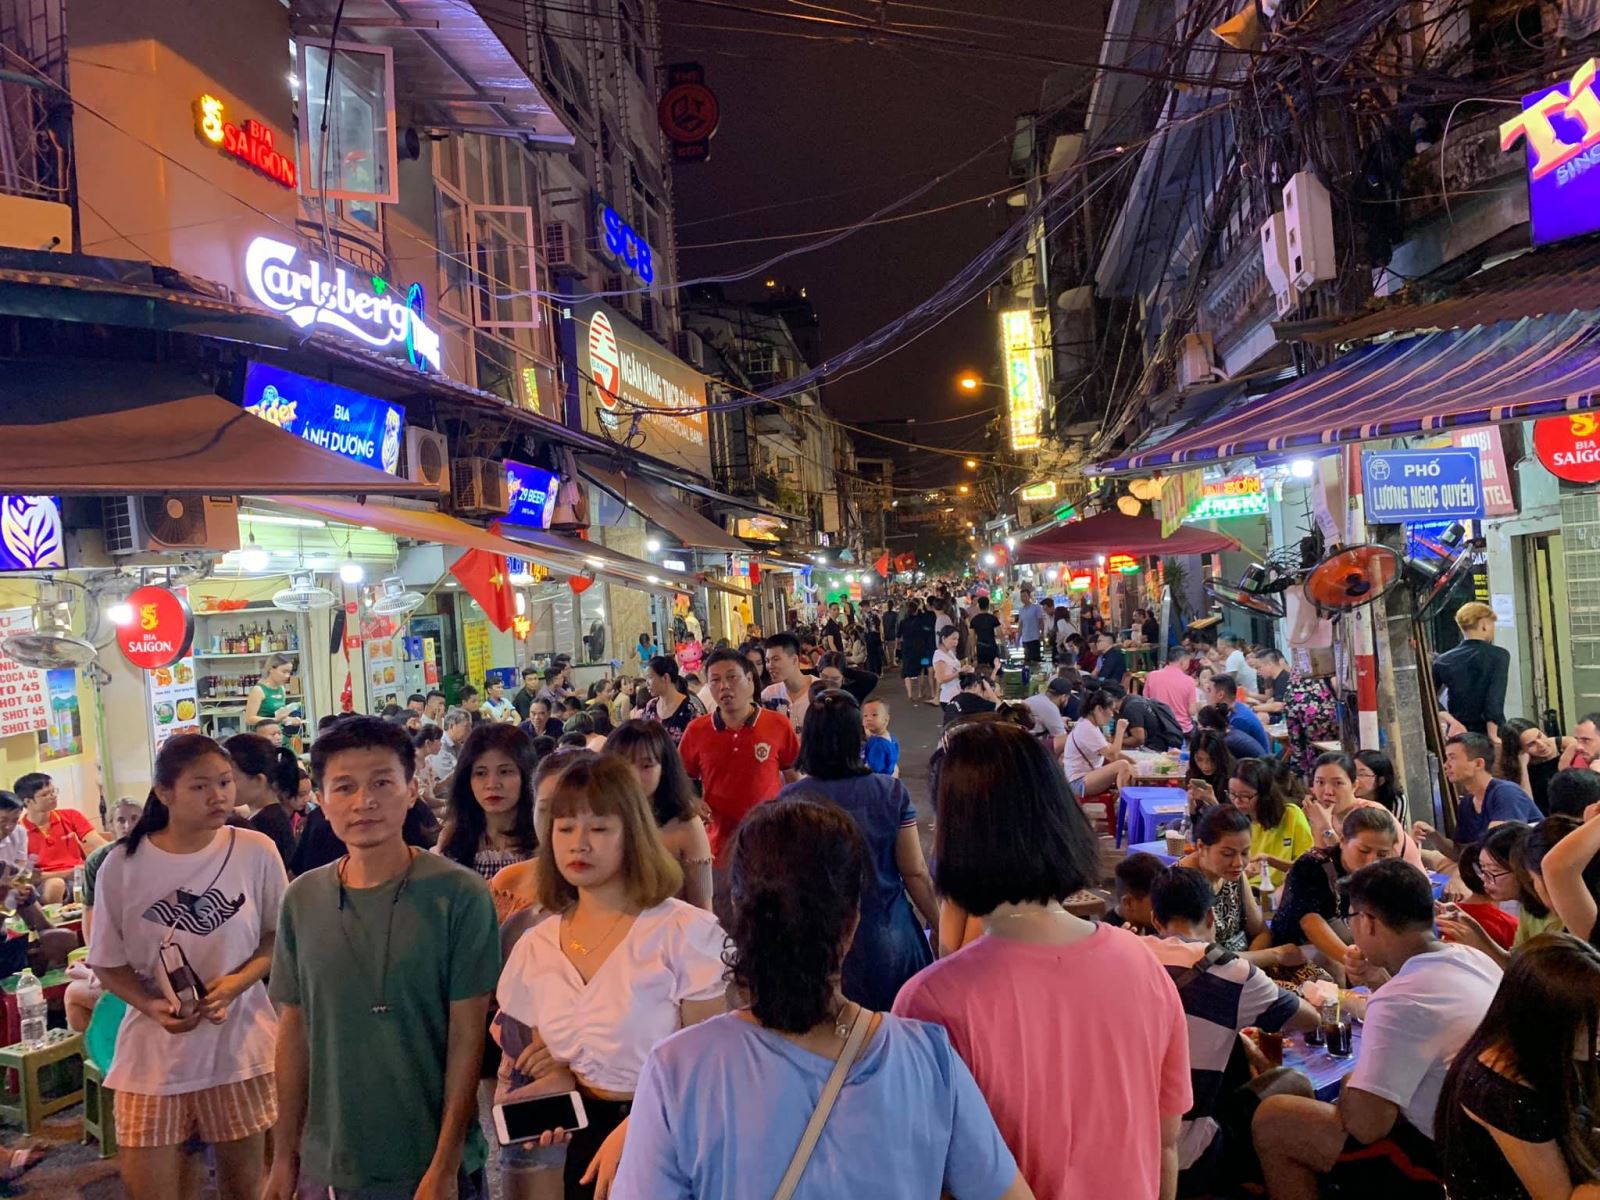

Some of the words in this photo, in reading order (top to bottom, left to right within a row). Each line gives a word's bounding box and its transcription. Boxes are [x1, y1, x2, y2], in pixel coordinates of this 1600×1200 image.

[250, 120, 273, 147] BIA
[224, 123, 296, 187] SAIGON
[604, 207, 653, 284] SCB
[246, 236, 410, 345] Carlsberg
[620, 351, 643, 392] NGÂN
[642, 361, 663, 403] HÀNG
[333, 404, 351, 421] BIA
[331, 433, 375, 458] DƯƠNG
[1575, 440, 1597, 450] BIA
[1404, 458, 1440, 477] PHỐ
[518, 487, 529, 501] 29
[528, 489, 546, 504] BEER
[1373, 484, 1409, 511] LƯƠNG
[1410, 484, 1439, 513] NGỌC
[1441, 476, 1475, 511] QUYẾN
[128, 641, 171, 653] SAIGON
[27, 670, 39, 681] 45
[22, 682, 40, 692] 45
[27, 693, 42, 704] 40
[2, 708, 29, 721] SHOT
[32, 706, 45, 716] 45
[1, 721, 31, 735] SHOT
[33, 718, 47, 729] 30
